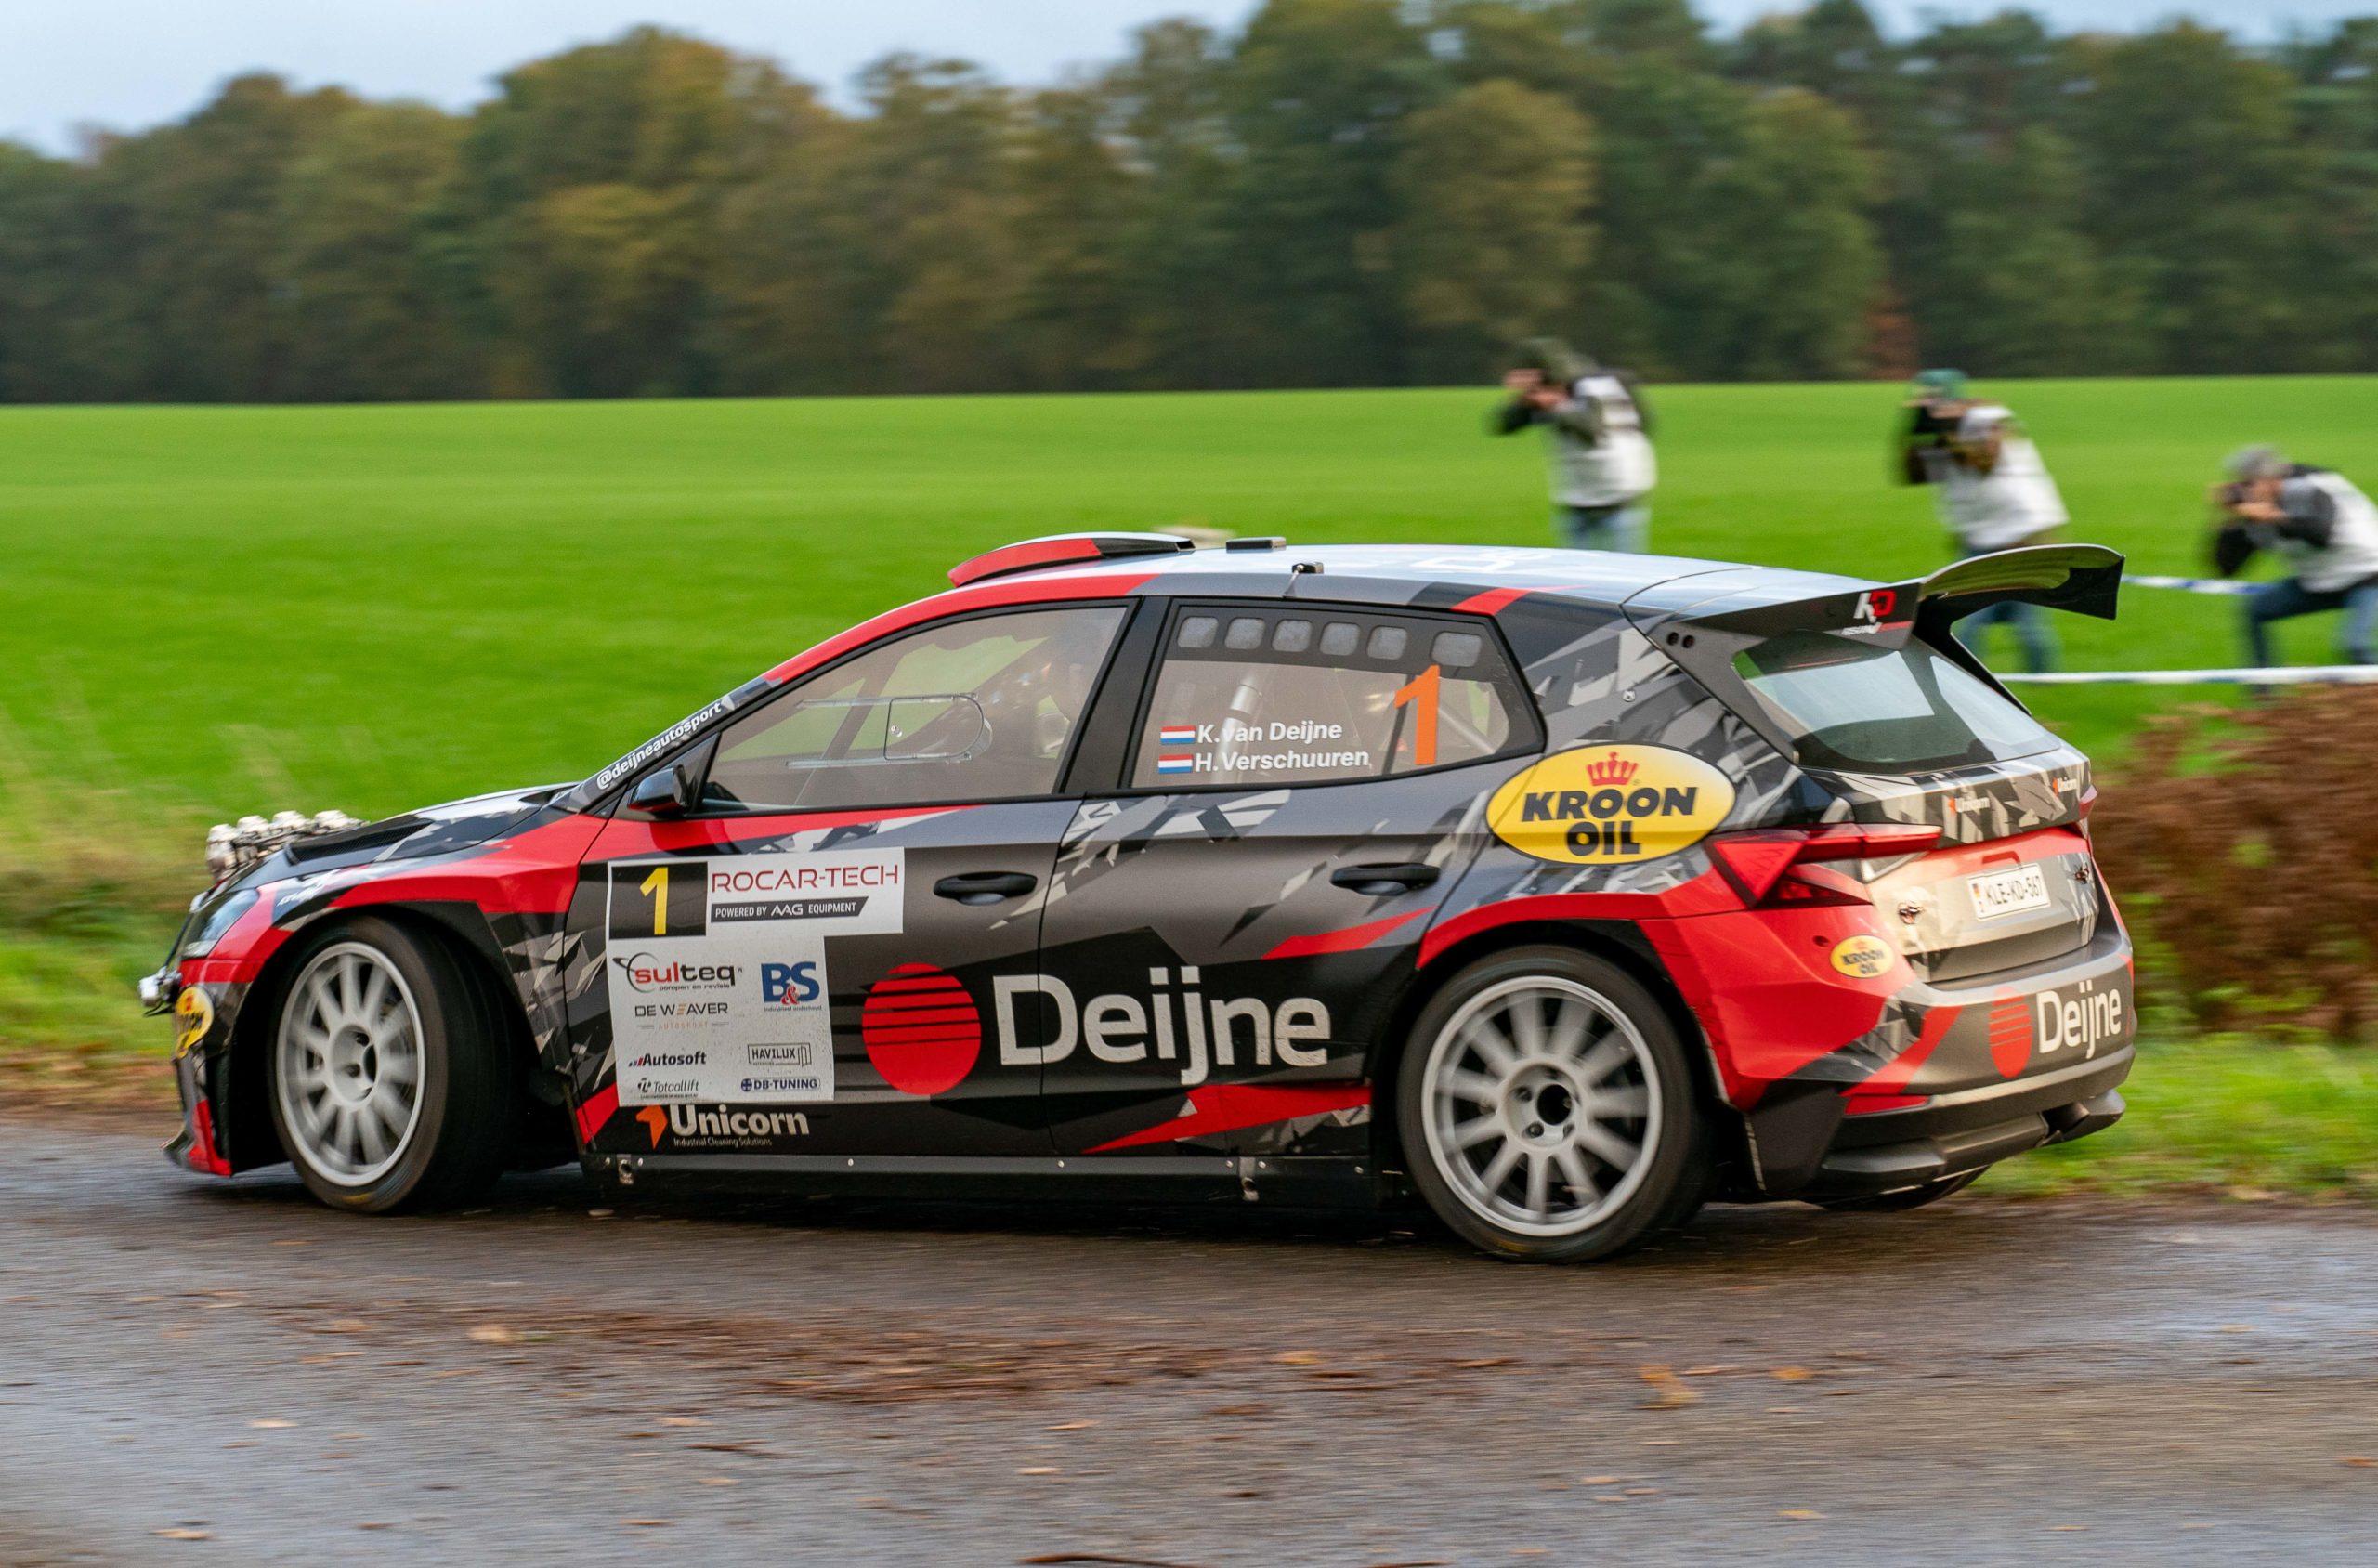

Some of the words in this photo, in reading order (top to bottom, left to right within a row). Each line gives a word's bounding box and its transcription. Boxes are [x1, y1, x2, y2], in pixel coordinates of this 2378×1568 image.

[1394, 664, 1440, 765] 1
[596, 702, 722, 790] @deijneautosport
[1269, 720, 1343, 744] Deijne
[1521, 787, 1699, 822] KROON
[1565, 820, 1641, 856] OIL
[712, 864, 899, 893] ROCAR-TECH
[639, 867, 668, 935] 1
[714, 906, 755, 918] POWERED
[756, 905, 767, 916] BY
[771, 903, 804, 916] AAG
[808, 902, 857, 914] EQUIPMENT
[634, 961, 736, 986] sulteq
[634, 1005, 657, 1017] DE
[992, 965, 1332, 1085] Deijne
[2036, 980, 2123, 1060] Deijne
[642, 1051, 707, 1067] Autosoft
[751, 1048, 796, 1060] HAVILUX
[670, 1104, 810, 1137] Unicorn
